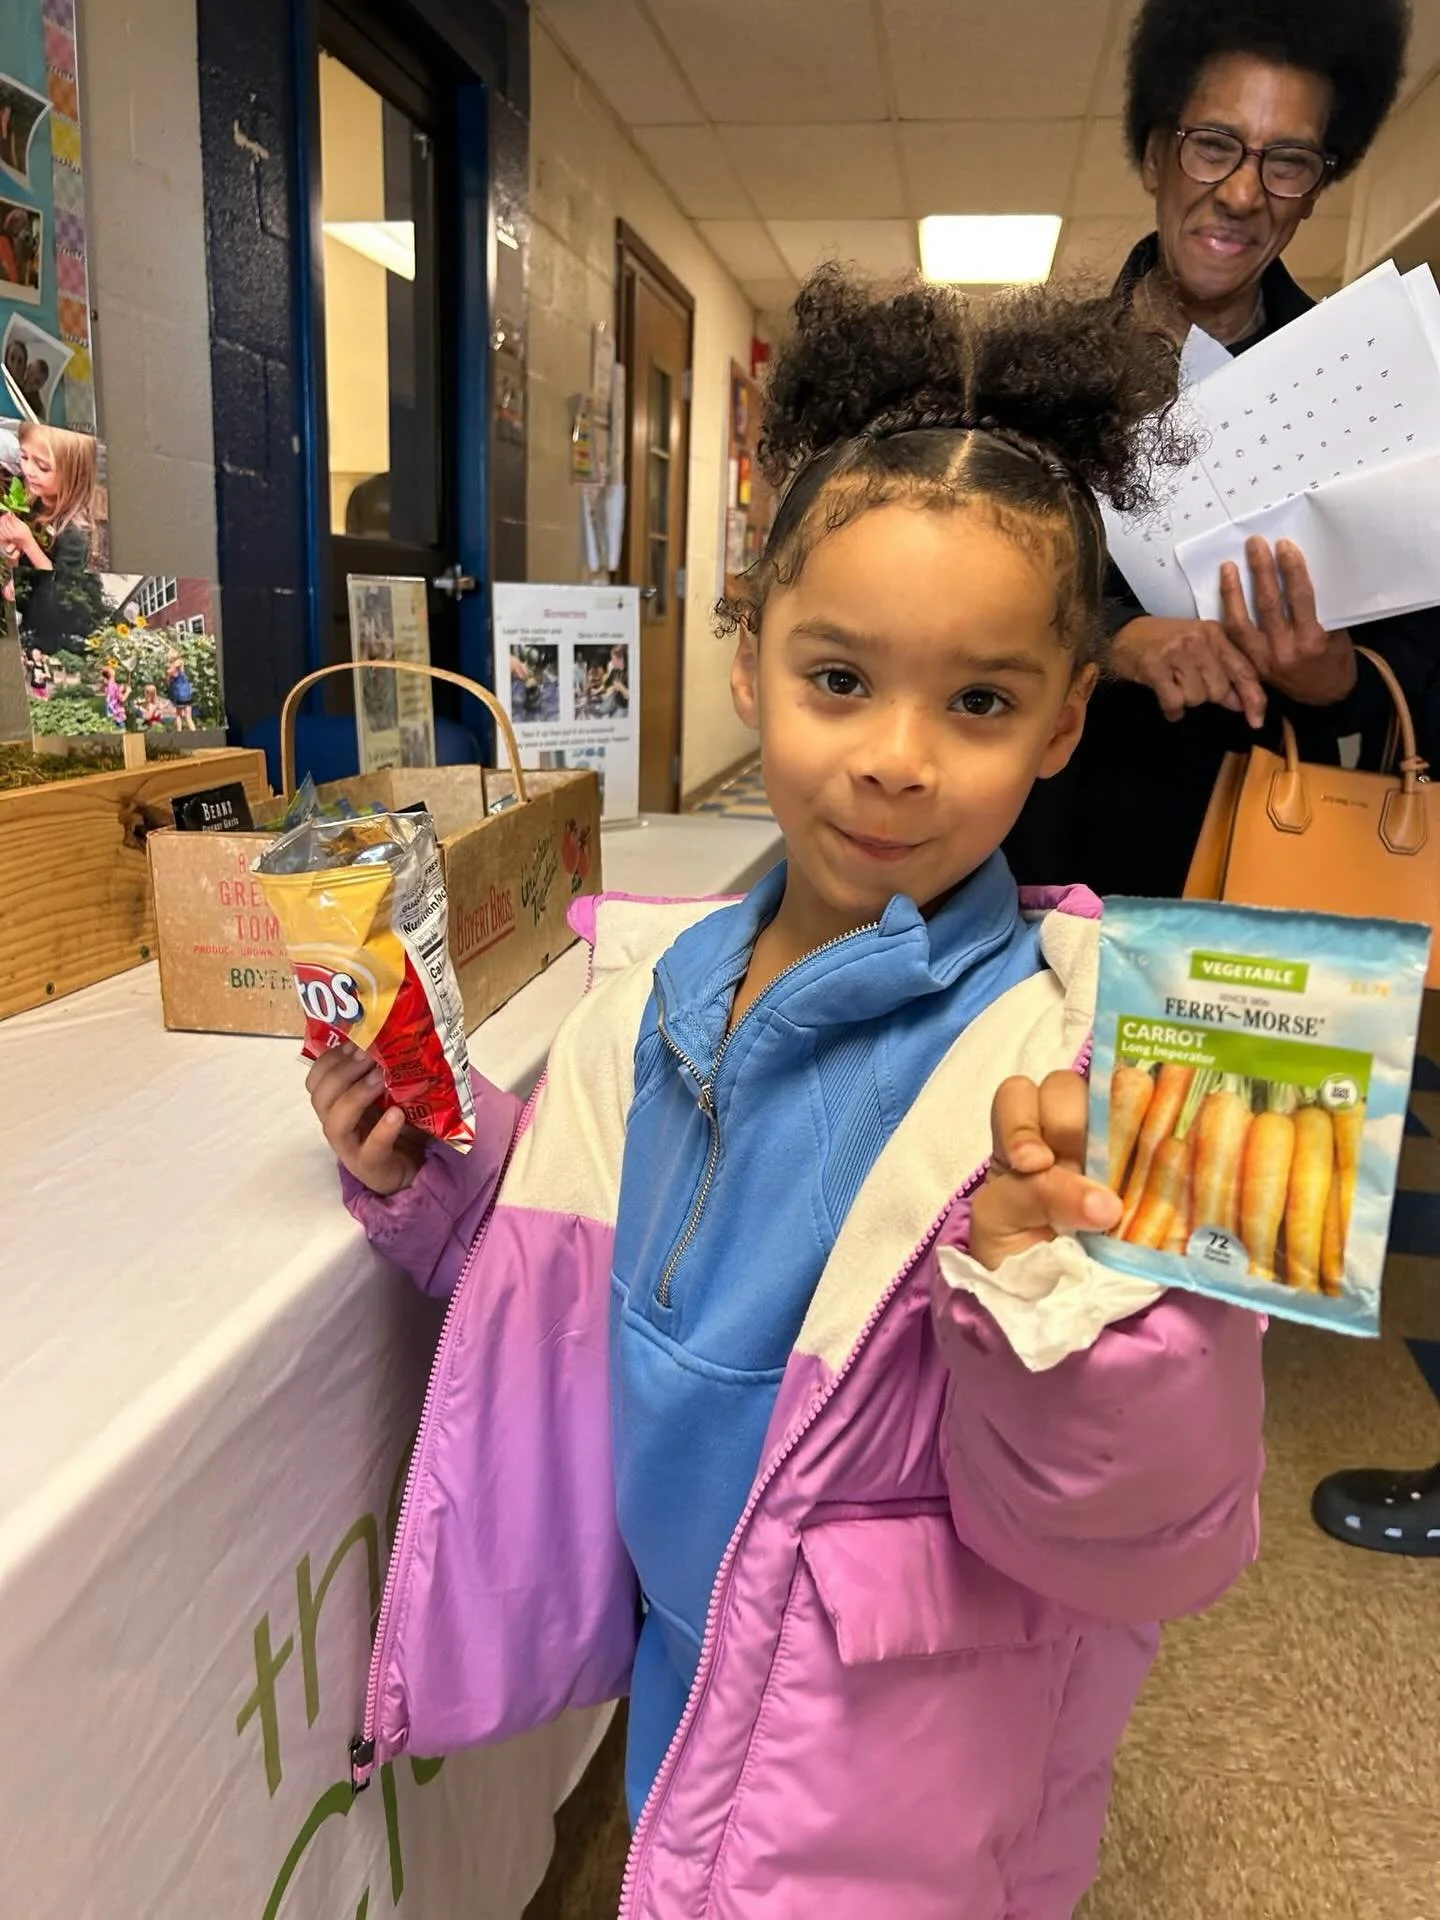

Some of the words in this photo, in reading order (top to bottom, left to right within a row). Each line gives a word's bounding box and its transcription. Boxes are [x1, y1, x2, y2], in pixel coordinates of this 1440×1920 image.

[1201, 960, 1295, 984] VEGETABLE
[1122, 1022, 1206, 1049] CARROT
[1121, 1040, 1151, 1057] Long
[1152, 1045, 1217, 1065] Imperator
[1208, 1231, 1230, 1250] 72
